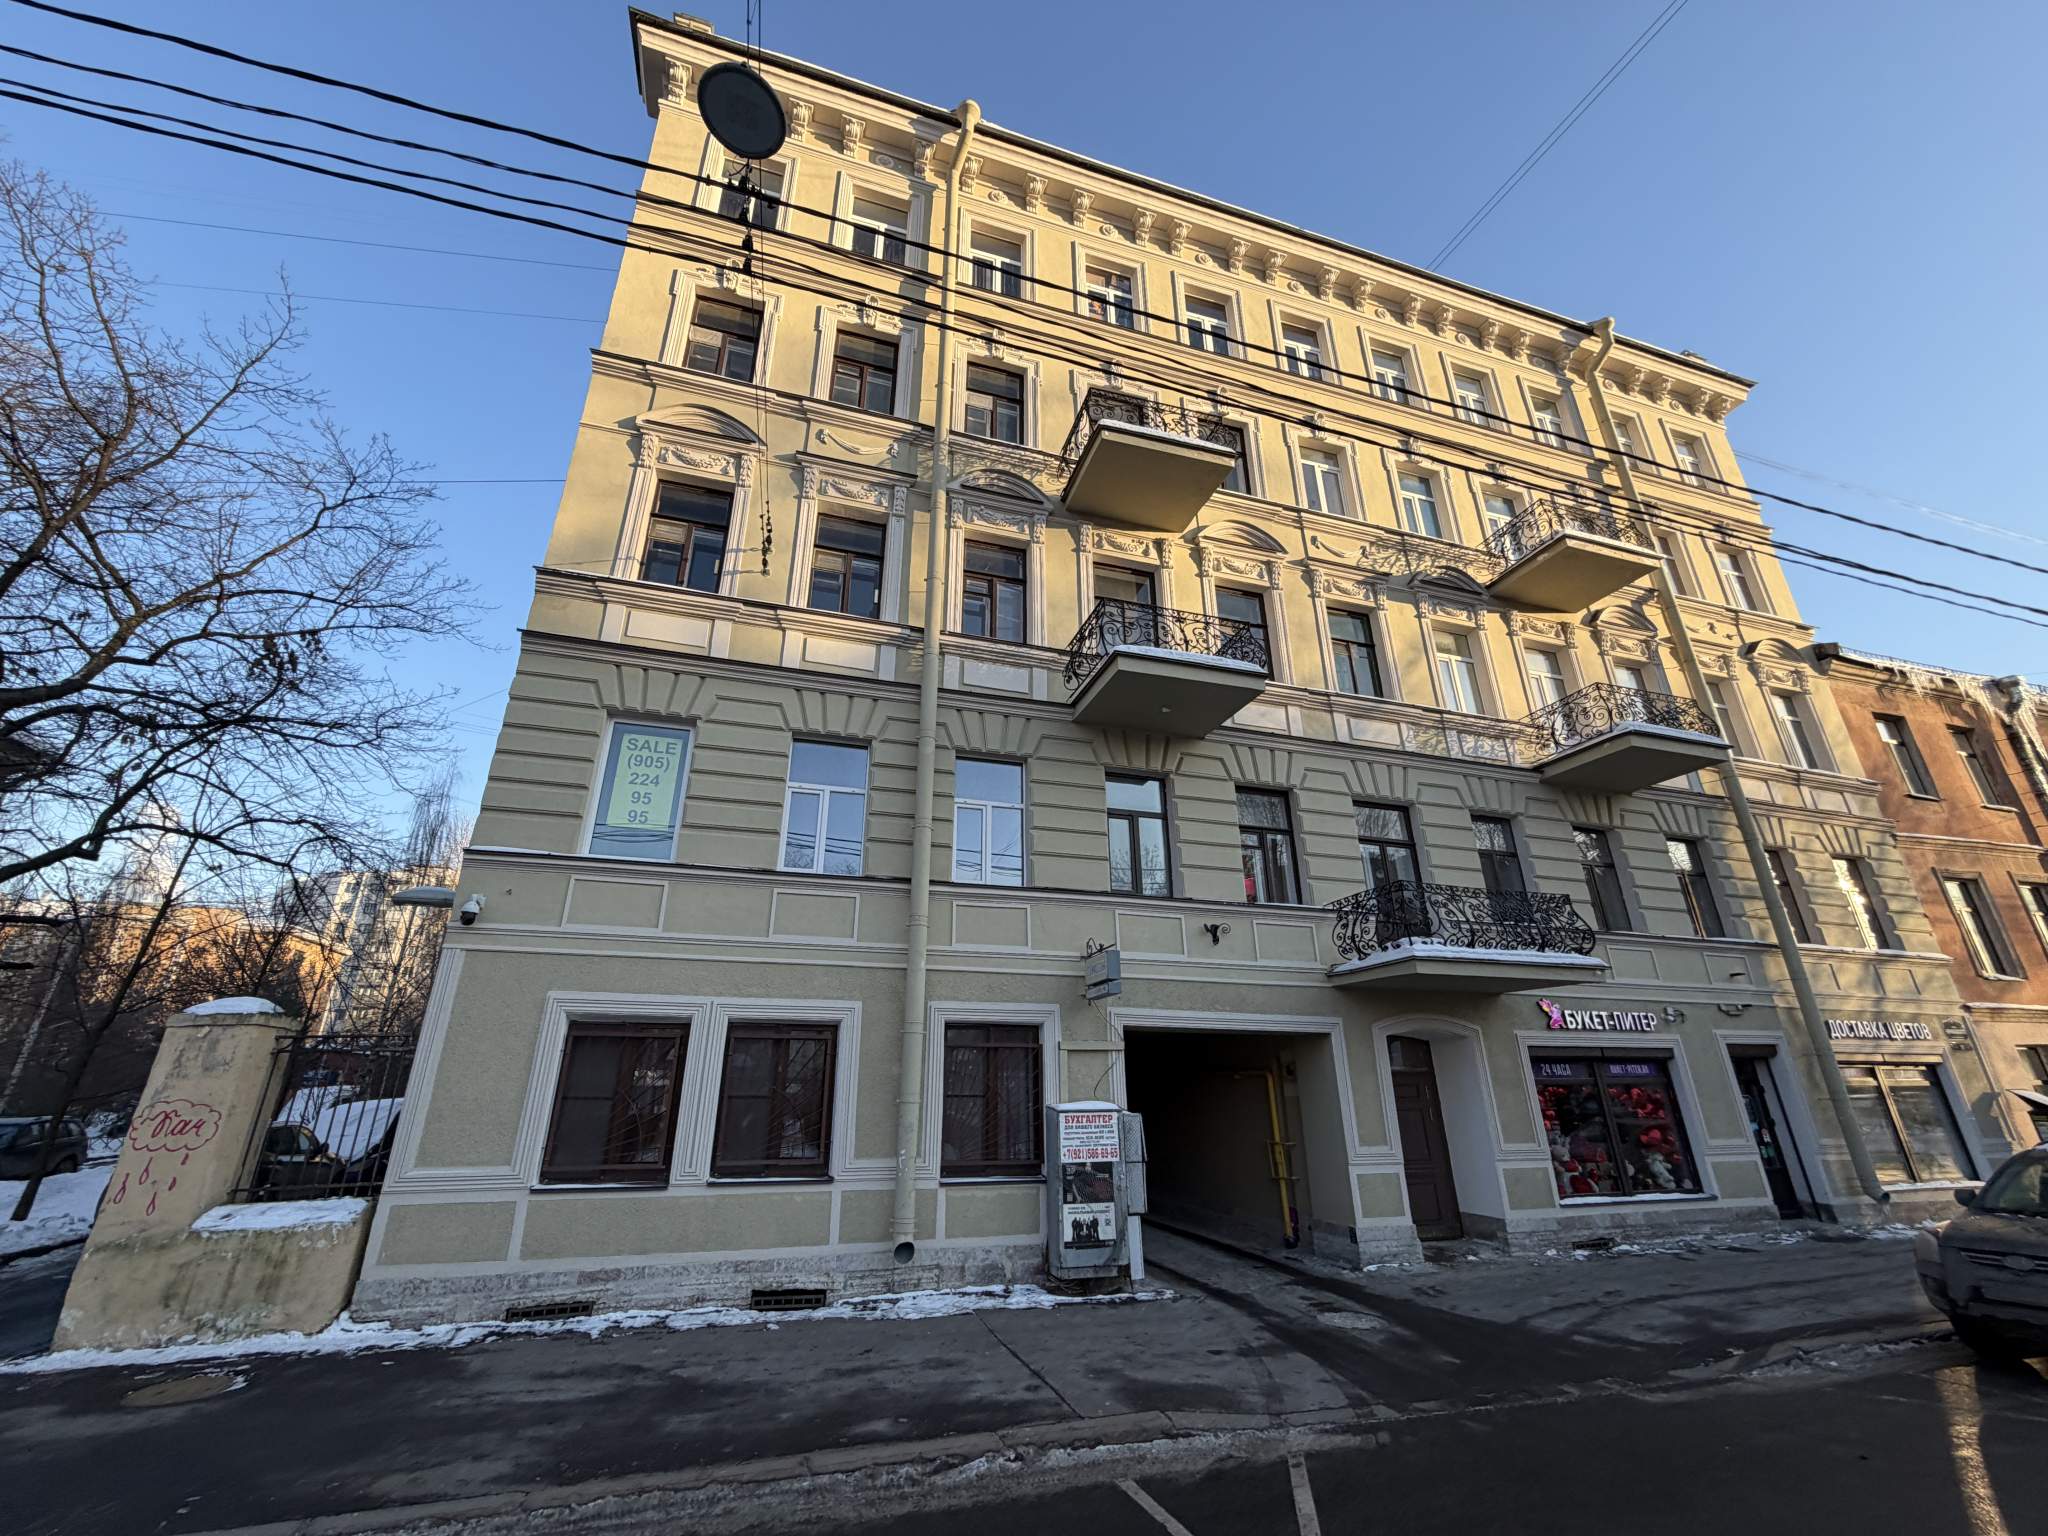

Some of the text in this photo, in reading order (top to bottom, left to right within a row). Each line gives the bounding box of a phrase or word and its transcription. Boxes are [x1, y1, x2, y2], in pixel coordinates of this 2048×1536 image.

[626, 738, 678, 756] SALE
[627, 753, 670, 773] (905)
[628, 772, 660, 787] 224
[631, 791, 653, 805] 95
[627, 809, 649, 824] 95
[1564, 1009, 1657, 1031] БУКЕТ-ПИТЕР
[1828, 1019, 1932, 1041] ДОСТАВКА ЦВЕТОВ
[1551, 1063, 1572, 1076] ЧАСА
[1064, 1114, 1113, 1124] БУХГАЛТЕР
